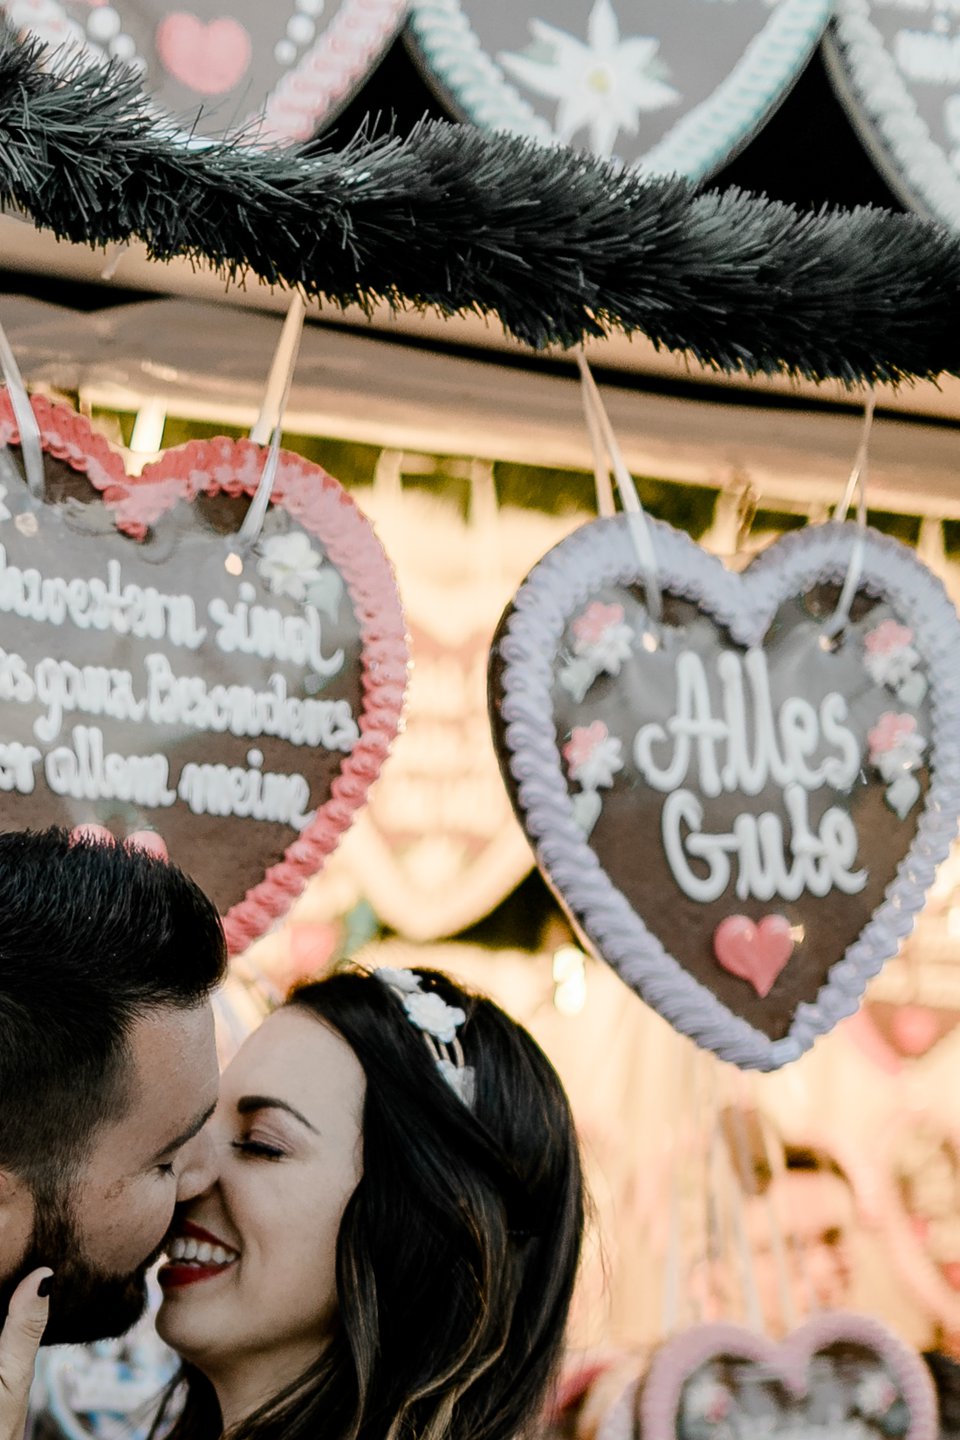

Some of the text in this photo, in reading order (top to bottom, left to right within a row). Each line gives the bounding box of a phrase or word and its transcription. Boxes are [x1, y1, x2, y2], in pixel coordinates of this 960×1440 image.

[208, 582, 344, 677] sind
[33, 657, 145, 742] ganz
[633, 649, 861, 798] Alles
[45, 725, 177, 808] allem
[664, 784, 868, 902] Gute
